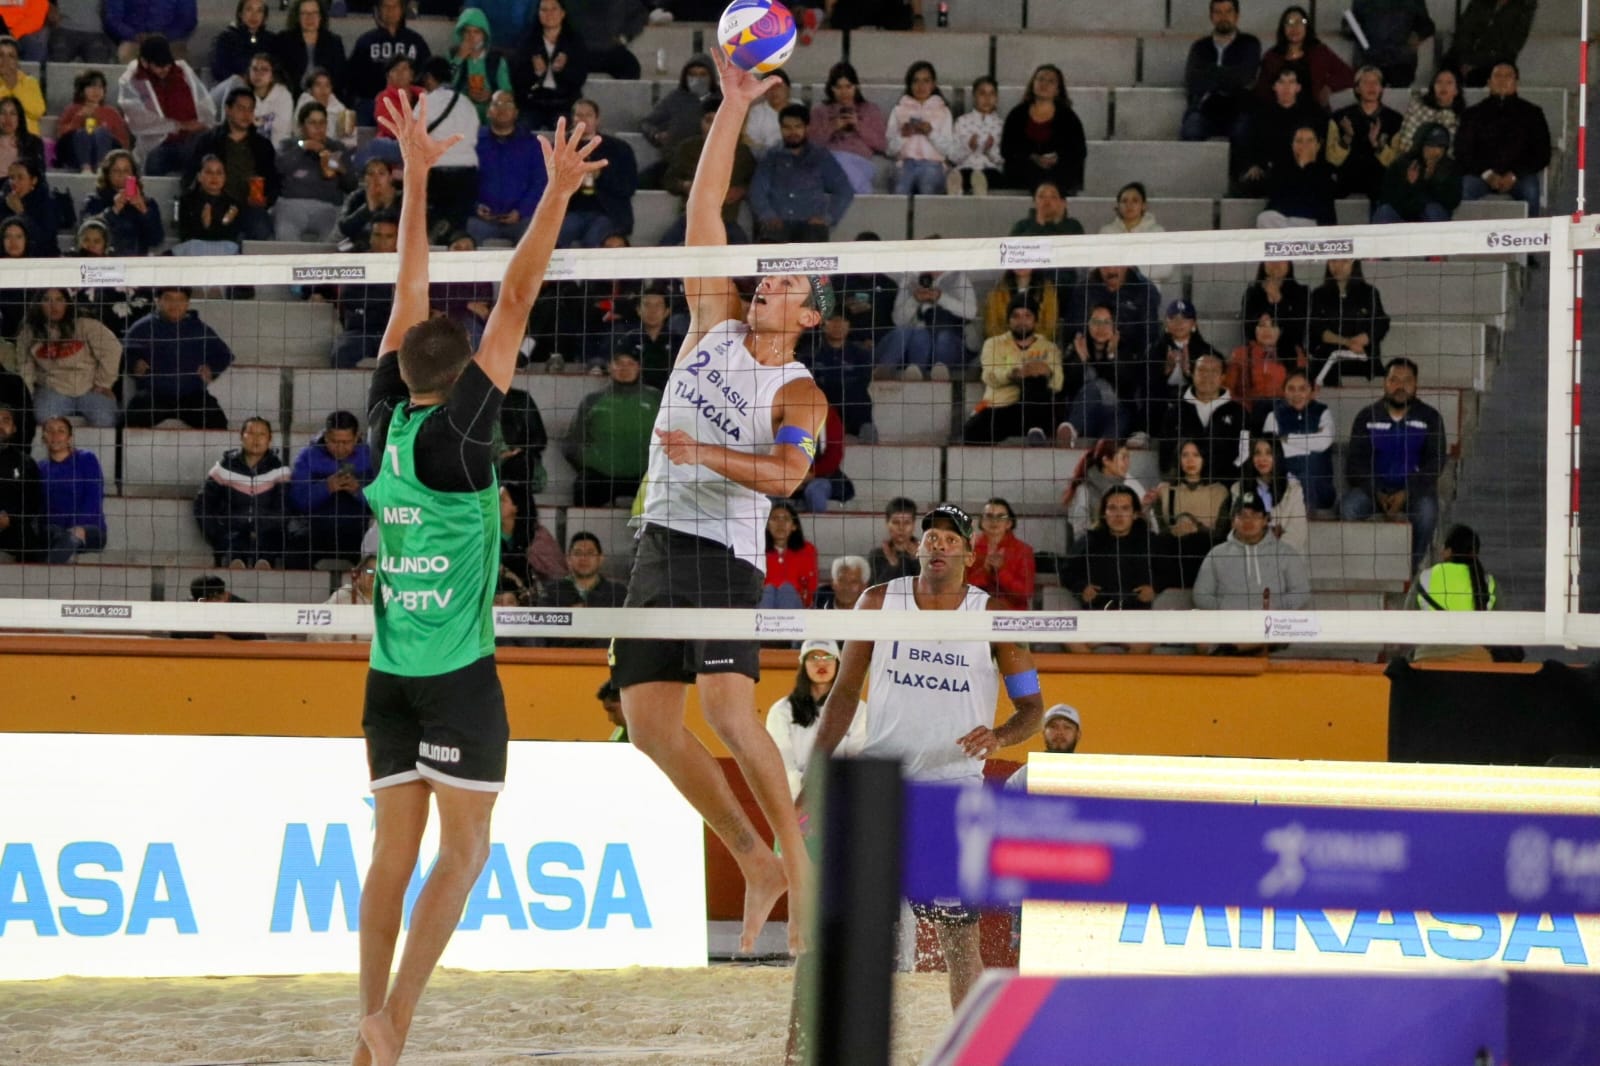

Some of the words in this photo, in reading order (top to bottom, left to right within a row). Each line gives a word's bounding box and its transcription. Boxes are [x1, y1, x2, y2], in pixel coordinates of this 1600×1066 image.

[1269, 243, 1321, 254] TLAXCALA
[1323, 242, 1350, 252] 2023
[296, 269, 339, 278] TLAXCALA
[340, 268, 364, 278] 2023
[760, 260, 808, 270] TLAXCALA
[687, 350, 712, 377] 2
[674, 380, 741, 442] TLAXCALA
[386, 444, 400, 477] 1
[383, 507, 422, 525] MEX
[64, 607, 106, 616] TLAXCALA
[107, 607, 129, 617] 2023
[297, 609, 332, 626] FIVB
[500, 614, 545, 624] TLAXCALA
[546, 614, 570, 624] 2023
[1048, 619, 1074, 629] 2023
[909, 647, 970, 667] BRASIL
[887, 669, 970, 692] TLAXCALA
